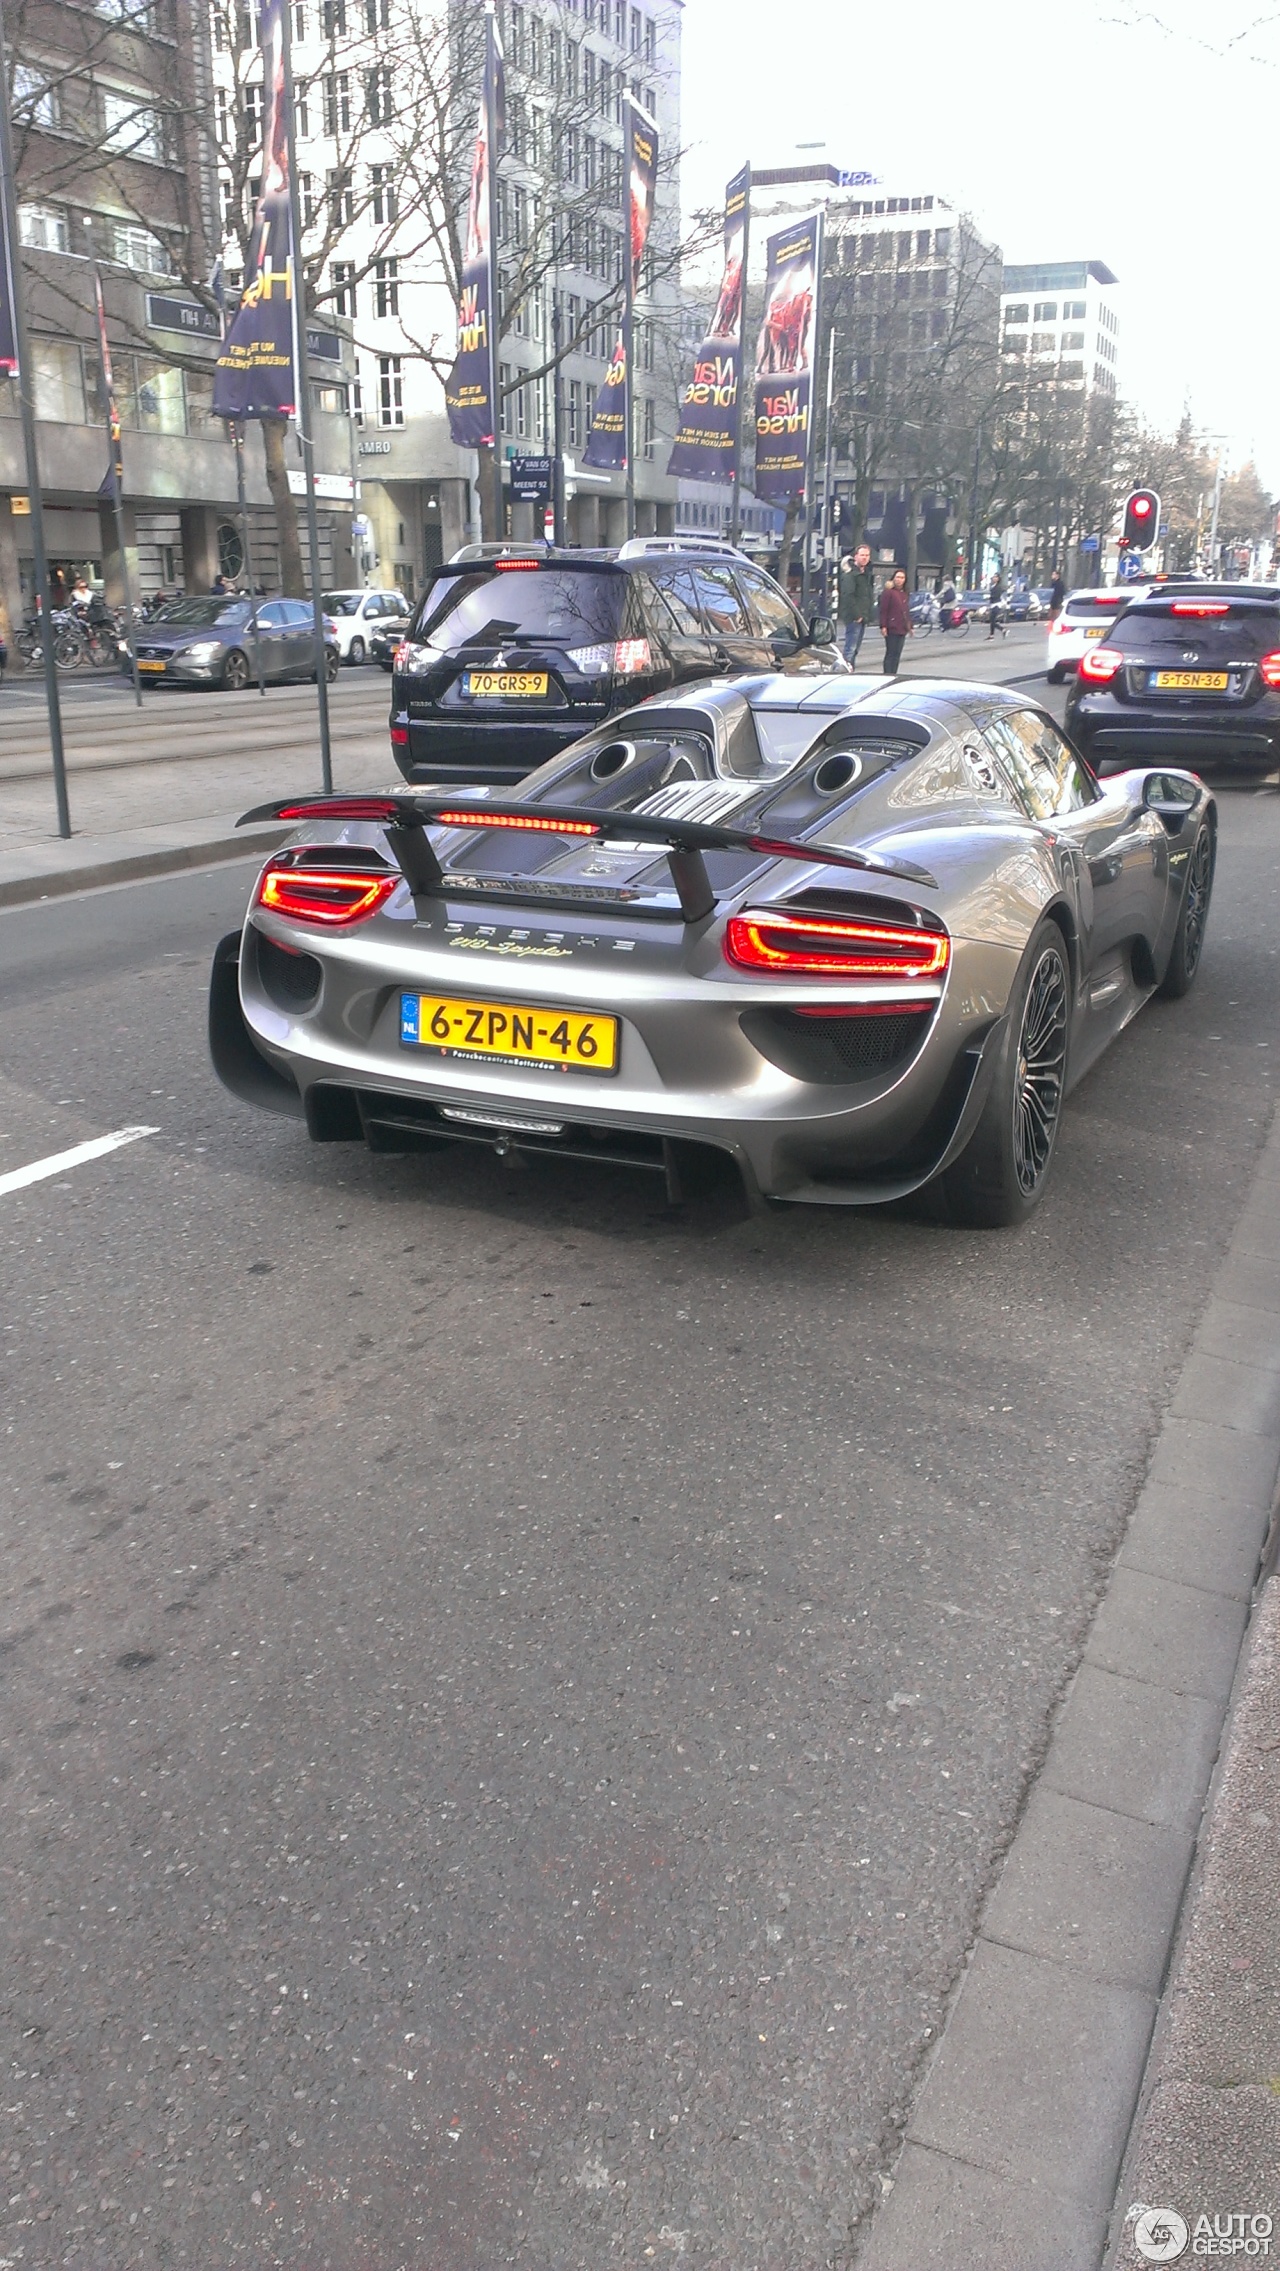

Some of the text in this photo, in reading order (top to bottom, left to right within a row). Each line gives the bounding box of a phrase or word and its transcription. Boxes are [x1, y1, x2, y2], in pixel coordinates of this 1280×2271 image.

[358, 441, 391, 453] AMRO
[524, 460, 549, 468] VAN OS
[513, 481, 548, 489] MEENT 92
[474, 675, 543, 691] 70-GRS-9
[1161, 674, 1221, 686] 5-TSN-36
[413, 920, 636, 951] PORSCHE
[485, 941, 573, 957] Spyder
[403, 1005, 598, 1058] NL 6-ZPN-46
